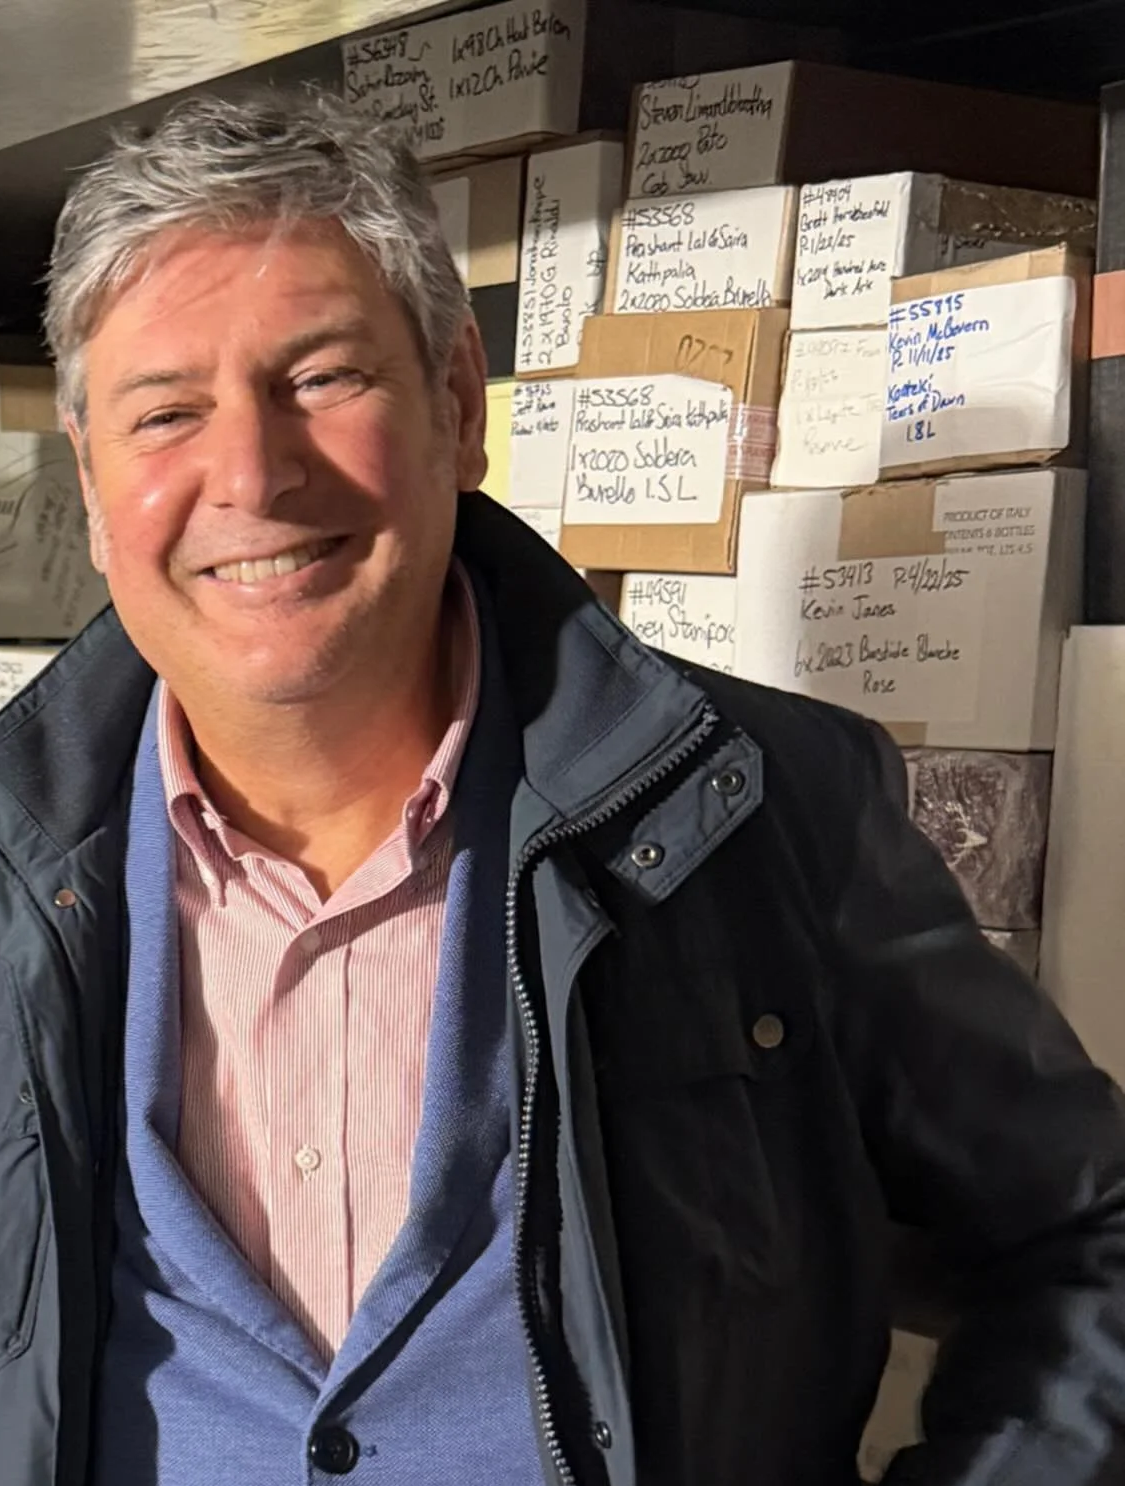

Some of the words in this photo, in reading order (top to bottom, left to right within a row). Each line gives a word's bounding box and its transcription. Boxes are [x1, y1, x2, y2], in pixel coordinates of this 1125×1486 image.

[621, 202, 696, 231] #53568
[577, 384, 654, 409] #53568
[943, 509, 989, 523] PRODUCT
[990, 508, 1005, 520] OF
[1006, 506, 1032, 520] ITALY
[994, 524, 1036, 539] BOTTLES
[798, 561, 874, 595] #53413
